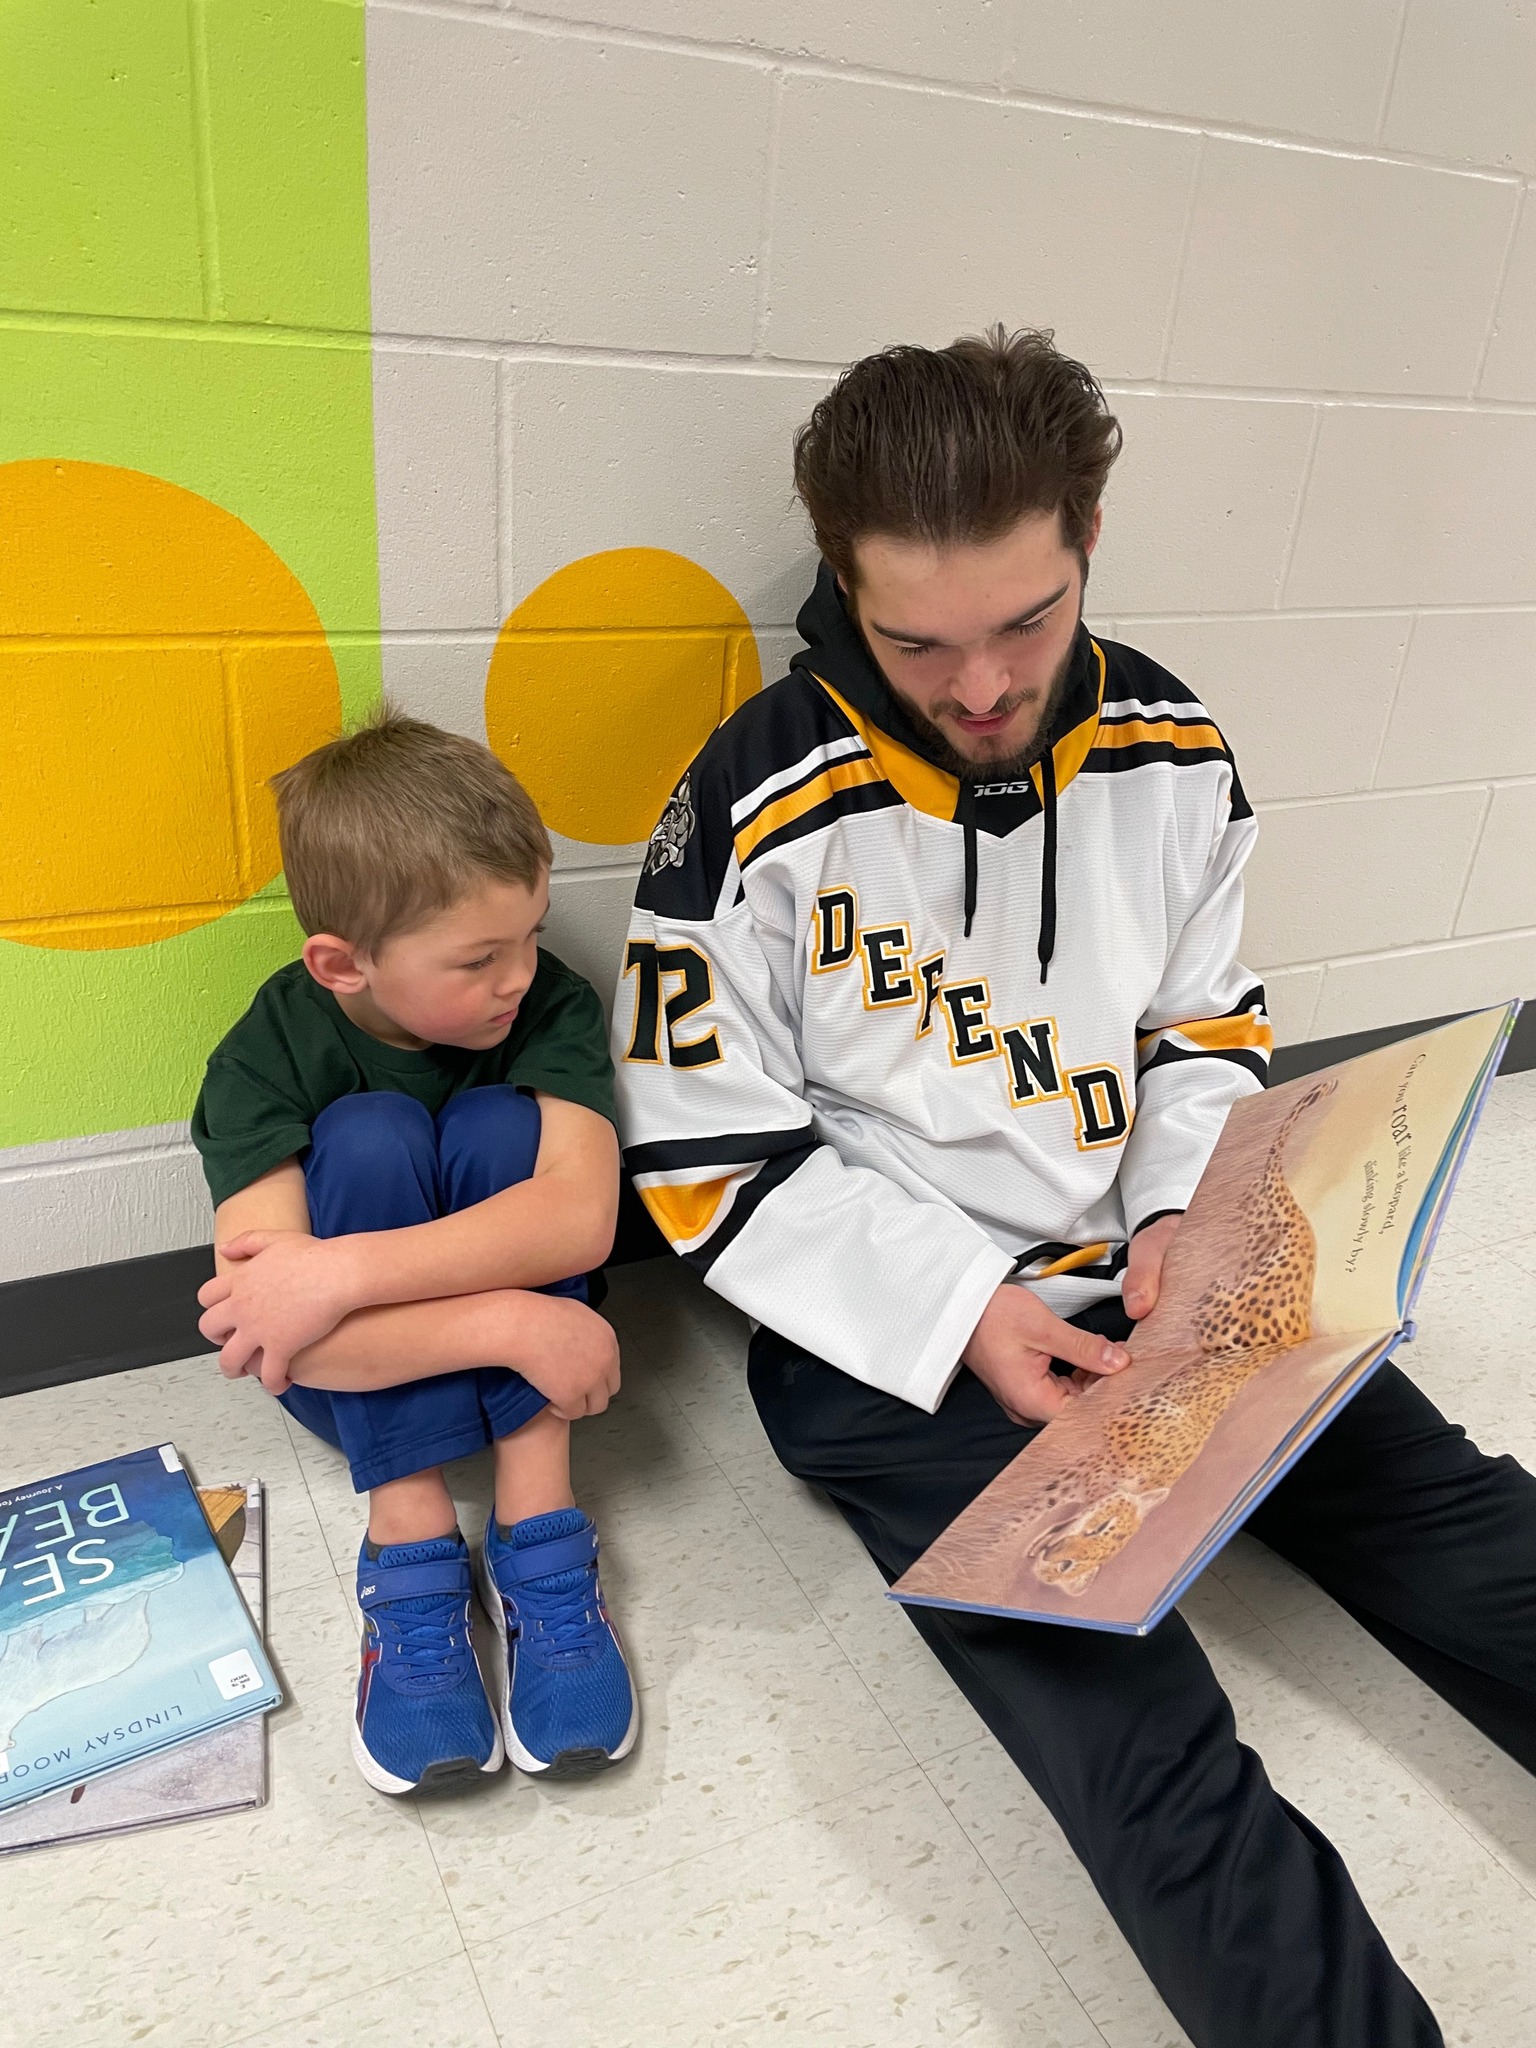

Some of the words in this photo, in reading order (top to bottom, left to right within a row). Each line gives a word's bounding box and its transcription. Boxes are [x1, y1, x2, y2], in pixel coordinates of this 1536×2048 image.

[973, 780, 1030, 798] JOG
[622, 939, 726, 1071] 12
[811, 884, 1136, 1152] DEFEND
[1405, 1053, 1426, 1078] Can
[1396, 1082, 1408, 1102] you
[1391, 1104, 1412, 1147] roar
[1397, 1145, 1412, 1169] like
[1397, 1170, 1406, 1179] a
[1352, 1203, 1376, 1243] slowly
[1378, 1178, 1409, 1235] leopard,
[1345, 1247, 1364, 1273] by?
[15, 1486, 53, 1502] Journey
[0, 1538, 115, 1606] SE
[84, 1704, 183, 1753] LINDSAY
